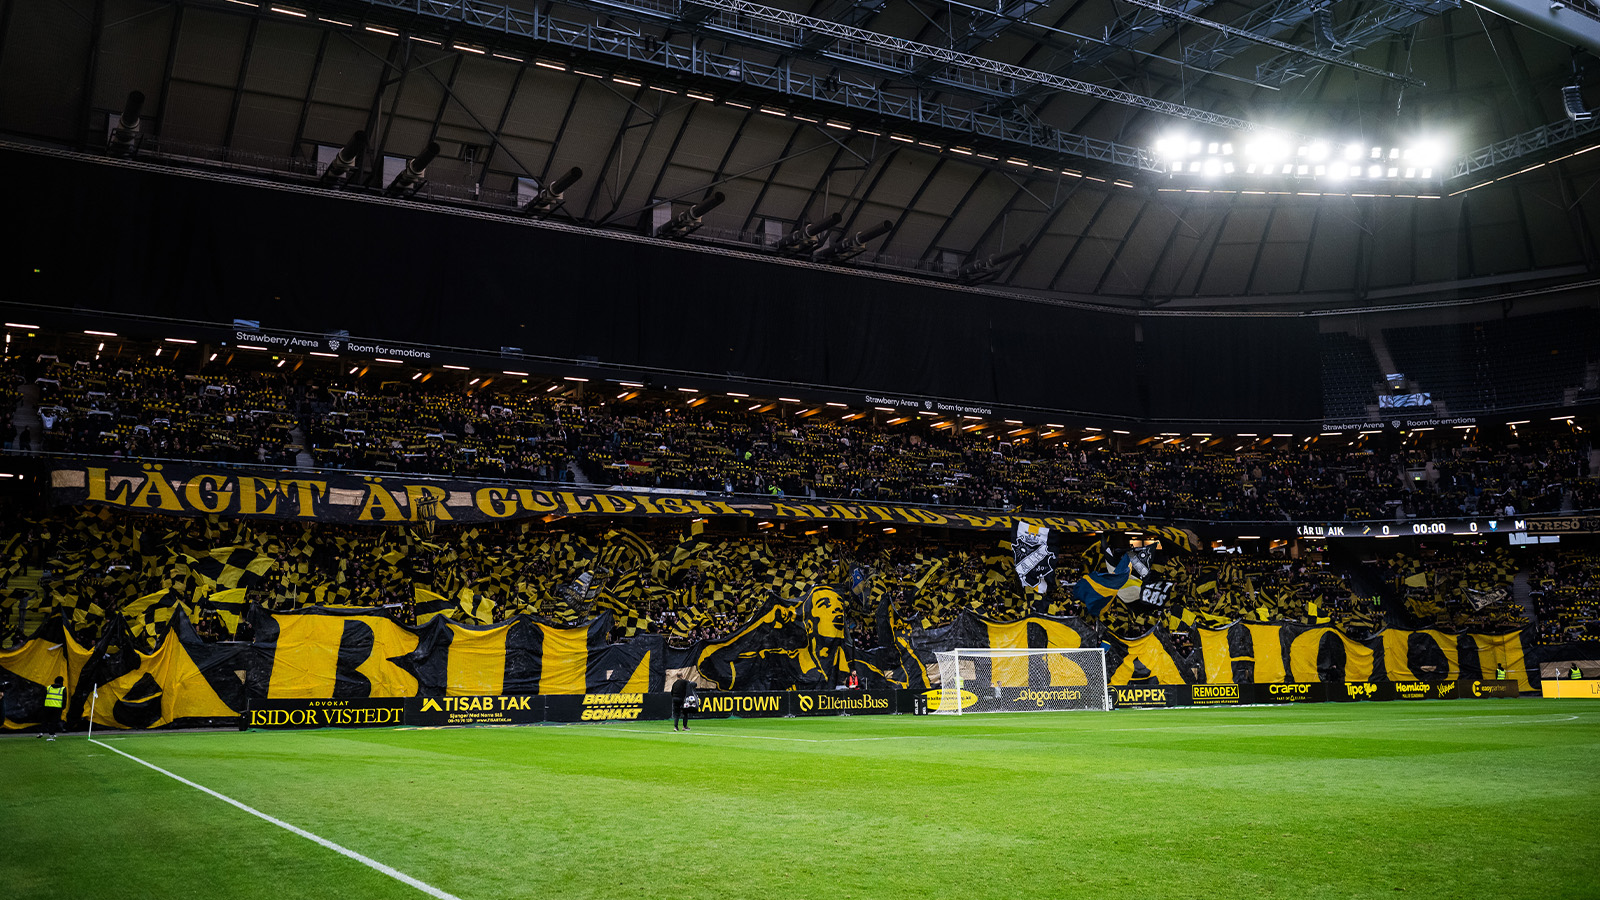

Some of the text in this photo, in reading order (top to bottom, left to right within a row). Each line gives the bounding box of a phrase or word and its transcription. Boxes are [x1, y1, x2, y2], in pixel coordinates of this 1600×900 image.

[236, 332, 319, 348] Strawberry Arena
[347, 343, 430, 358] Room for emotions
[865, 395, 919, 407] Strawberry Arena
[937, 402, 954, 410] Room
[964, 406, 992, 415] emotions
[85, 463, 328, 518] LÄGET
[357, 475, 454, 522] ÄR
[1413, 523, 1446, 534] 00:00
[1469, 522, 1478, 532] 0
[1527, 518, 1580, 530] TYRESÖ
[1328, 526, 1344, 536] AIK
[1382, 526, 1389, 535] 0
[1142, 589, 1167, 606] RAS
[1194, 687, 1237, 697] REMODEX
[1396, 682, 1430, 693] Hemköp
[582, 694, 644, 705] BRUNNA
[1118, 689, 1166, 702] KAPPEX
[443, 696, 531, 711] TISAB TAK
[818, 694, 889, 710] ElléniusBuss
[249, 708, 404, 726] ISIDOR VISTEDT
[581, 708, 643, 720] SCHAKT
